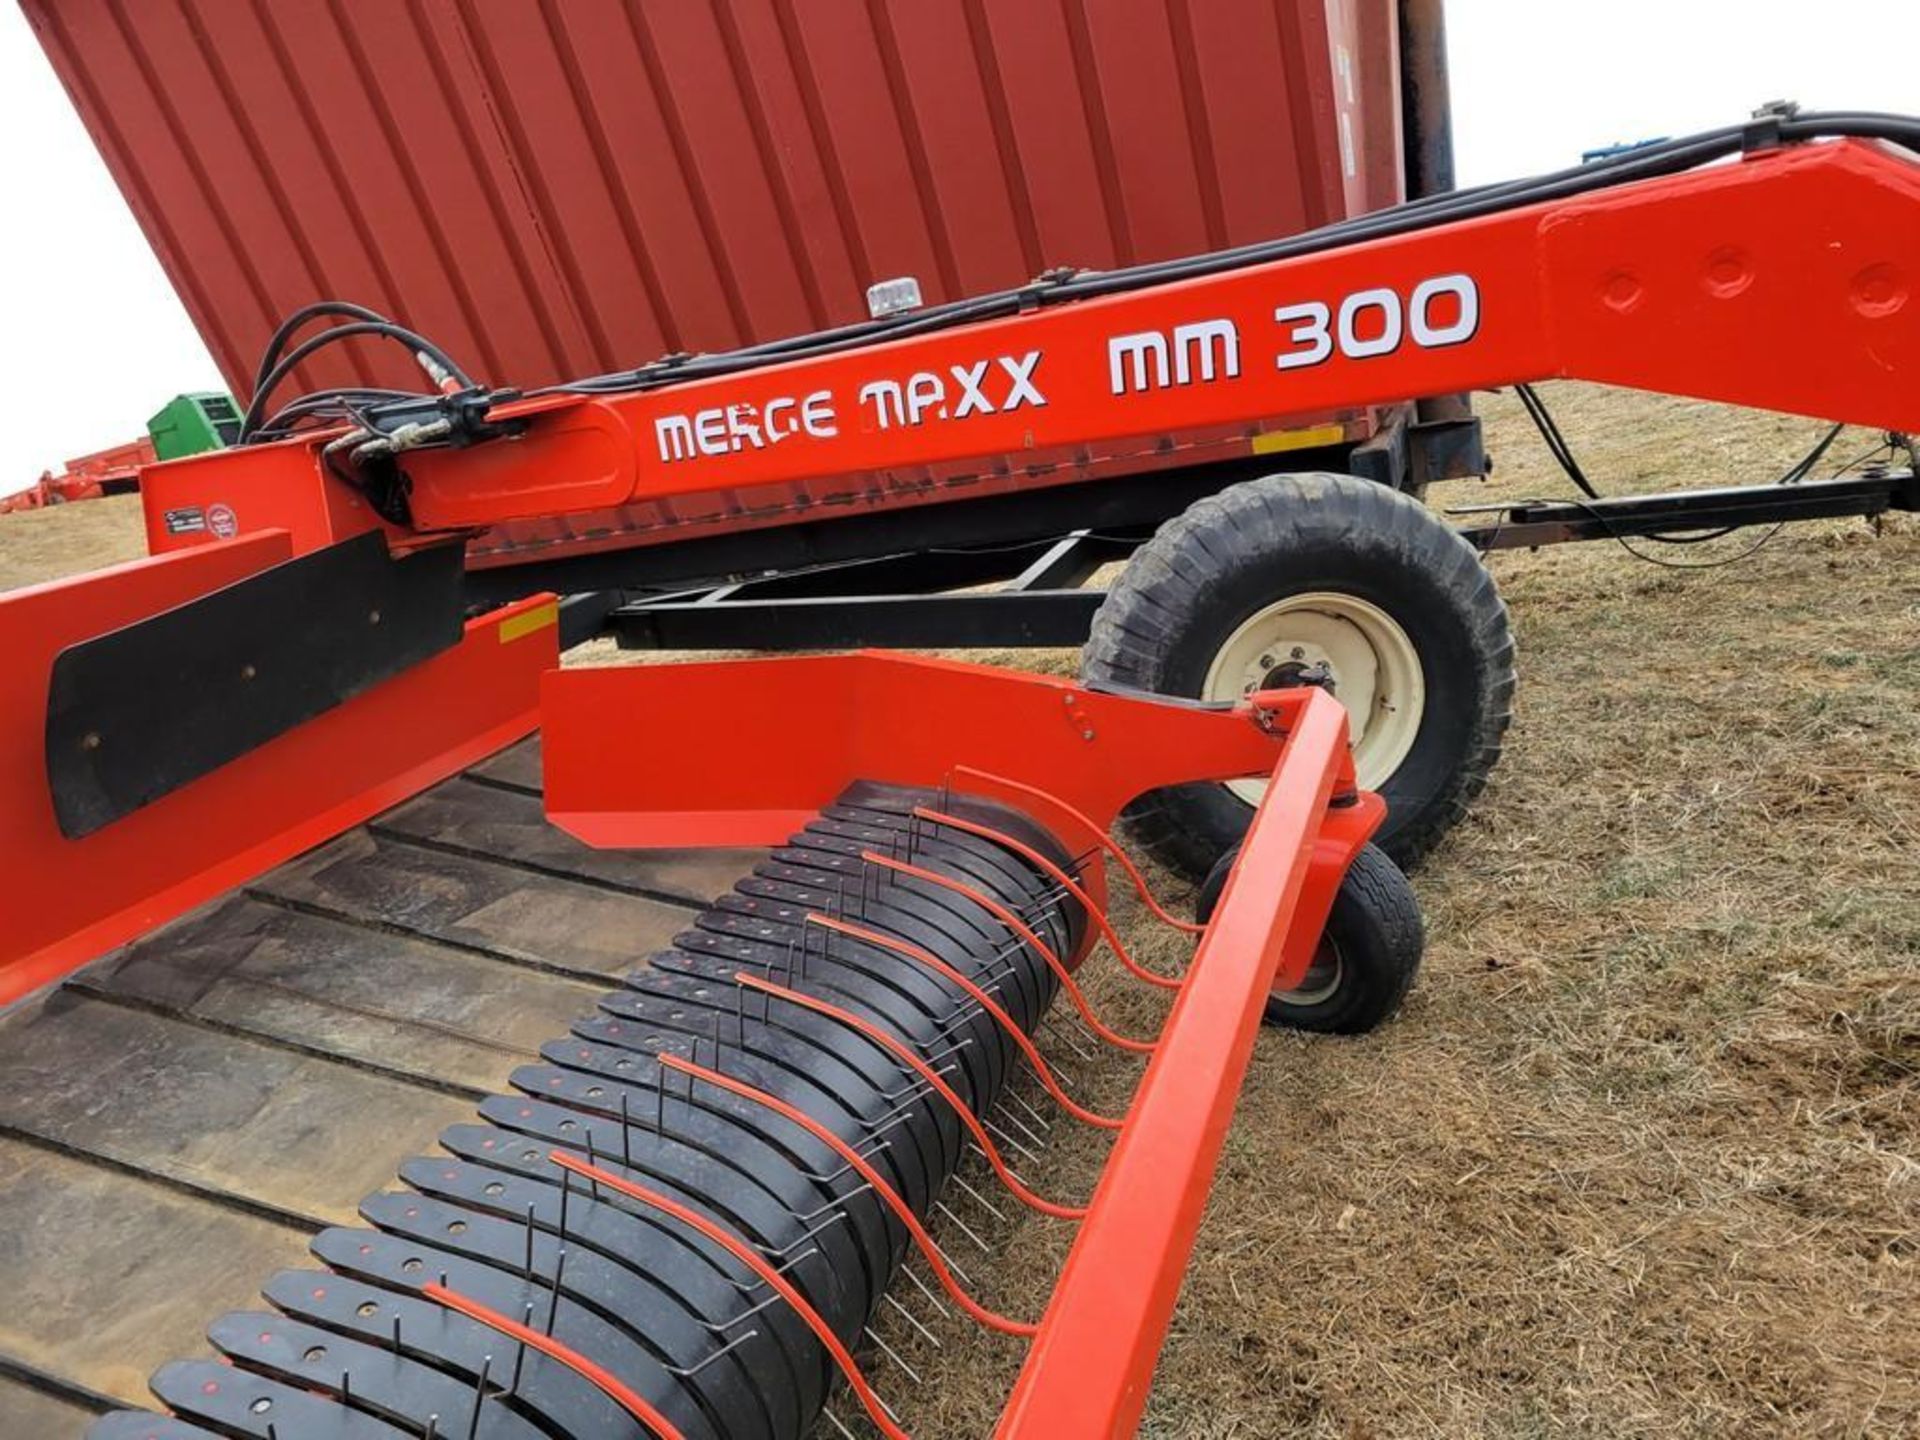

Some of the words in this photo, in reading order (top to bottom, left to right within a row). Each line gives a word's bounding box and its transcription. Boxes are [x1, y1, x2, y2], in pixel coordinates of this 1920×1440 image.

[656, 391, 838, 462] MERGE
[1109, 319, 1240, 393] MM
[1275, 274, 1479, 369] 300
